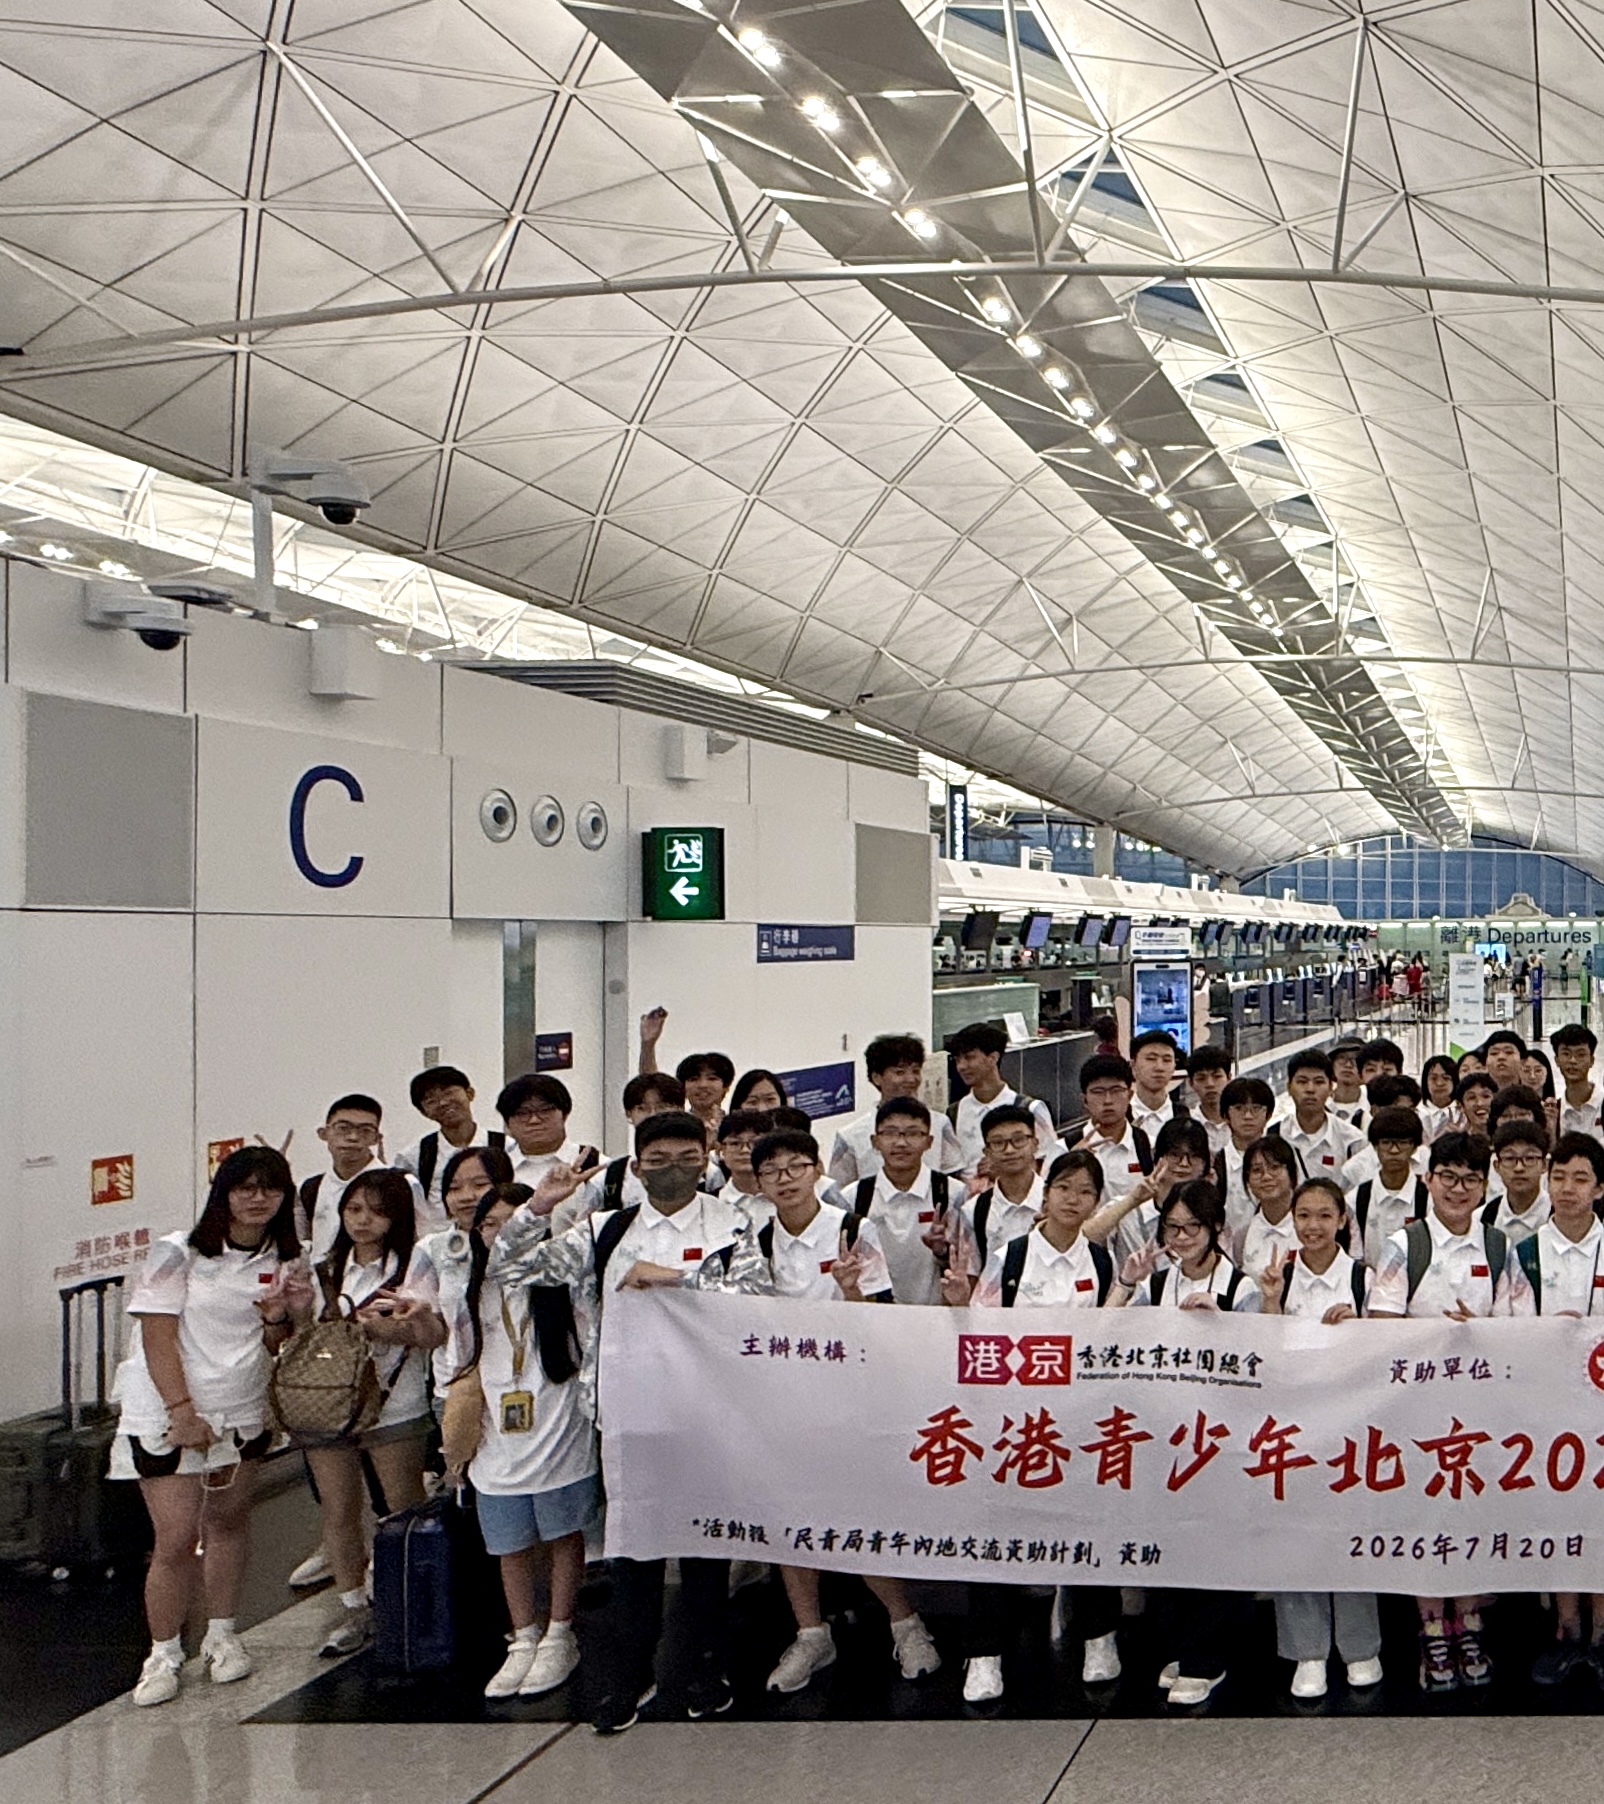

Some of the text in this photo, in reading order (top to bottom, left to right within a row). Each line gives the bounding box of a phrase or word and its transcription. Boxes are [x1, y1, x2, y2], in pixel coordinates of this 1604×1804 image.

[289, 765, 364, 888] C
[1440, 926, 1482, 944] 離港
[1487, 927, 1592, 946] Departures
[53, 1262, 84, 1280] FIRE
[90, 1251, 130, 1270] HOSE
[1076, 1372, 1120, 1381] Federation
[1121, 1372, 1131, 1380] of
[1132, 1372, 1154, 1382] Hong
[1156, 1373, 1177, 1382] Kong
[1179, 1373, 1207, 1385] Beijing
[1349, 1532, 1584, 1565] 2026年7月20日
